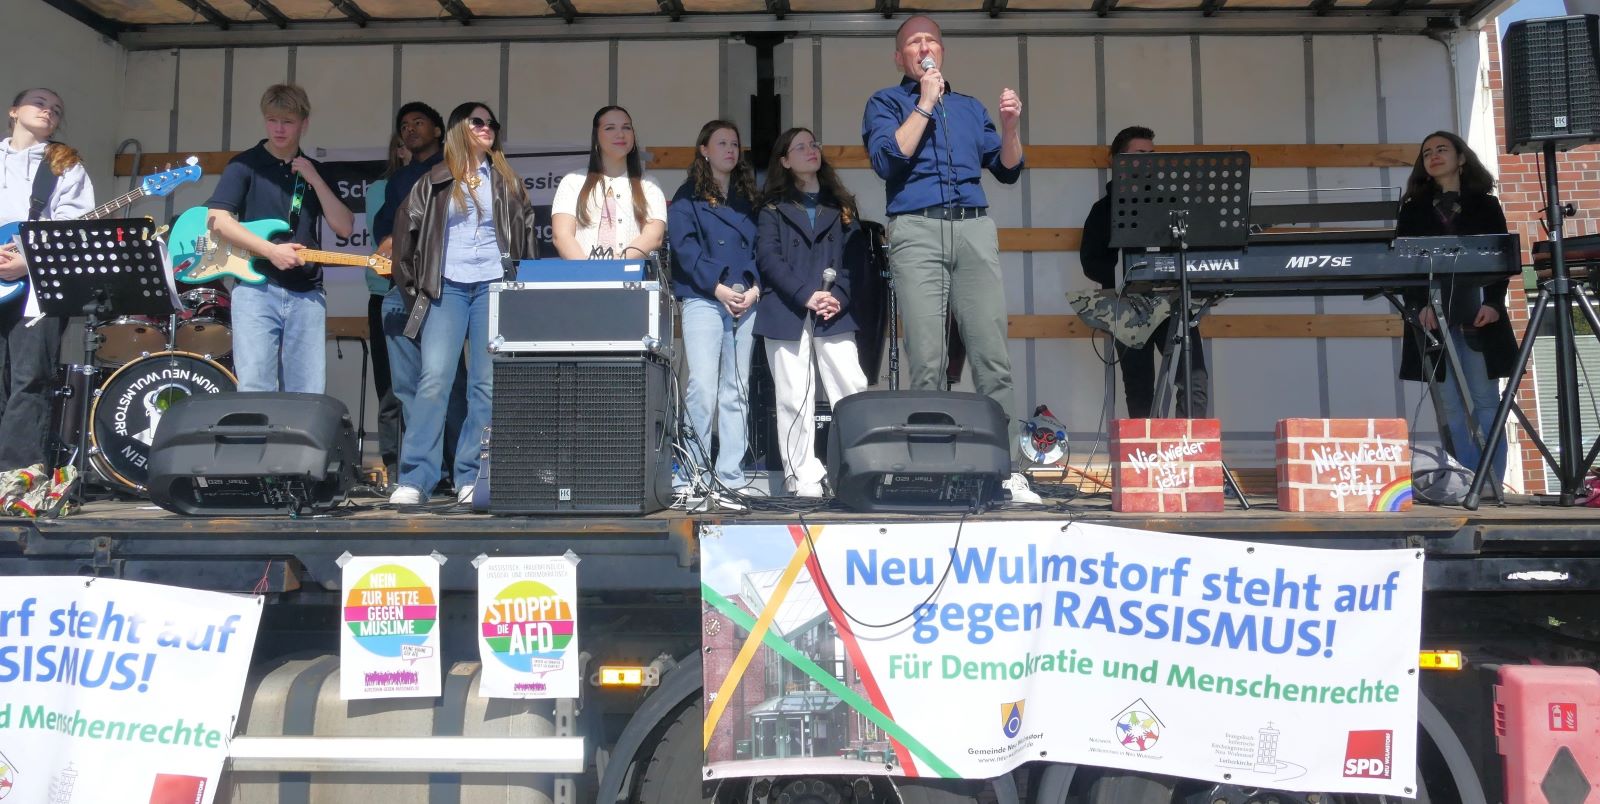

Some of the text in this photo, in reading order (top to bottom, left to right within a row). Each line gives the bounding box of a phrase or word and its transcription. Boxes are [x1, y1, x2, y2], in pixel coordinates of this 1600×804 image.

[1186, 259, 1240, 272] KAWAI
[162, 369, 191, 380] NEU
[114, 371, 161, 437] WULMSTORF
[121, 445, 149, 470] EIN
[1128, 434, 1206, 474] Nie wieder
[1159, 461, 1178, 475] ist
[1312, 434, 1408, 474] Nie wieder
[1155, 464, 1195, 492] jetzt!
[1330, 467, 1383, 499] jetzt!
[1338, 464, 1361, 481] ist
[370, 573, 396, 588] NEIN
[845, 543, 1400, 613] Neu Wulmstorf steht auf
[361, 590, 420, 606] ZUR HETZE
[489, 596, 562, 625] STOPPT
[0, 597, 242, 653] rf steht auf
[367, 605, 404, 621] GEGEN
[912, 590, 1336, 659] gegen RASSISMUS!
[360, 619, 415, 637] MUSLIME
[497, 621, 553, 657] DIE AFD
[889, 649, 1400, 704] Für Demokratie und Menschenrechte
[19, 704, 221, 748] Menschenrechte
[967, 746, 1006, 755] Gemeinde
[1345, 758, 1384, 775] SPD
